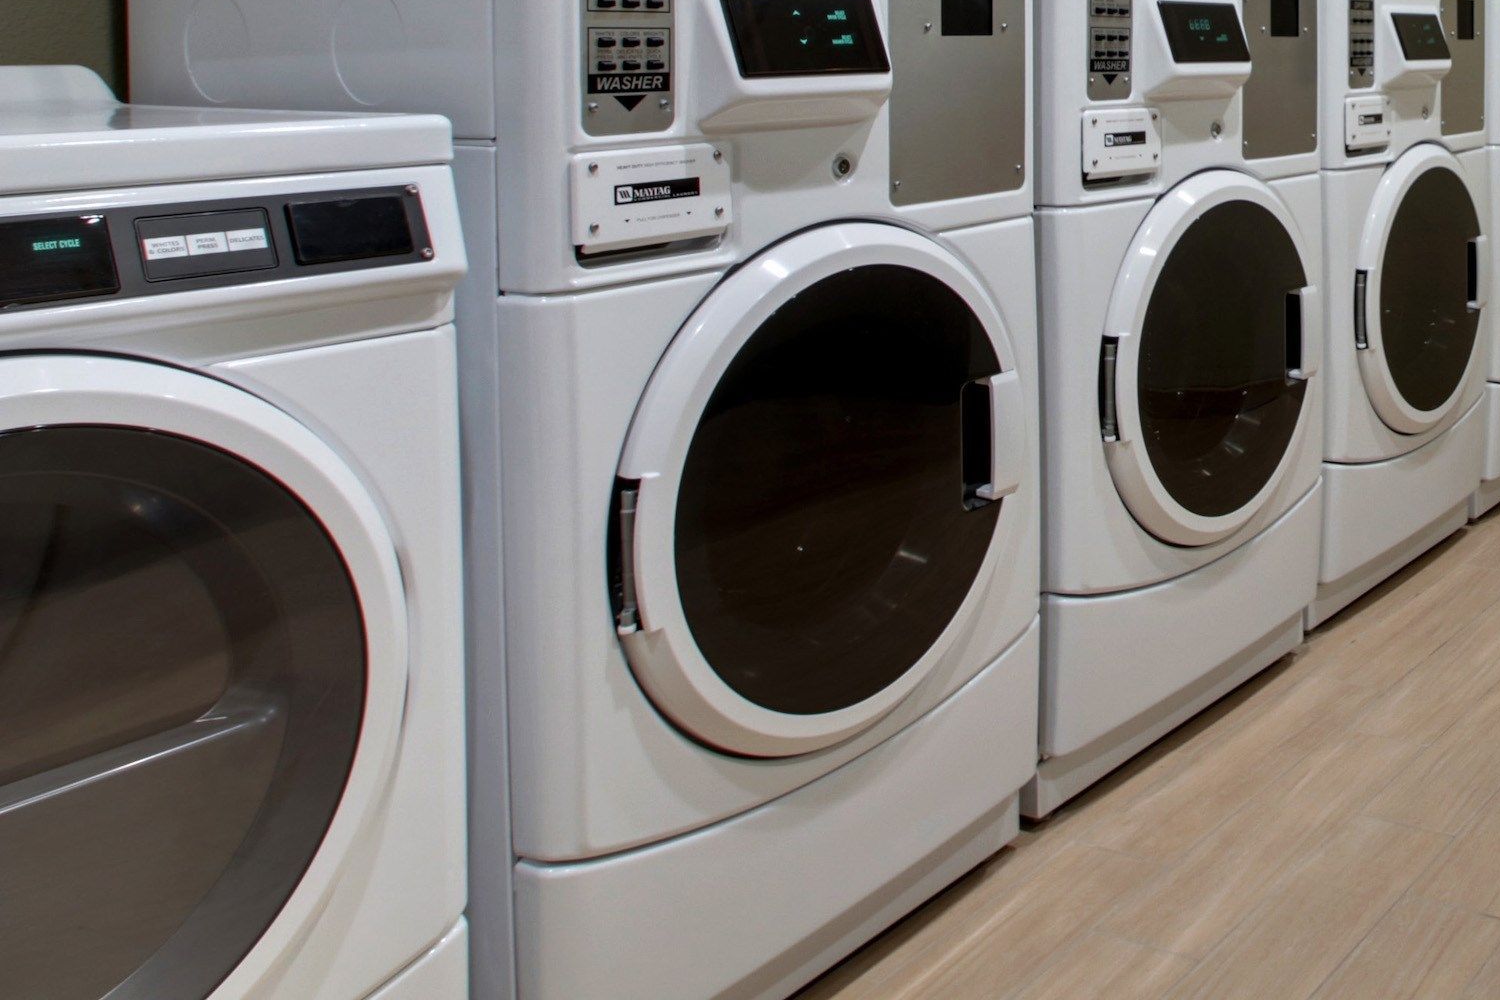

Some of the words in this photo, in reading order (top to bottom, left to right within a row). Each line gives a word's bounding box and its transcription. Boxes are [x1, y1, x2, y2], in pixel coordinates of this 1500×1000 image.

[1093, 60, 1127, 71] WASHER
[596, 75, 663, 91] WASHER
[633, 185, 671, 198] MAYTAG
[32, 240, 58, 251] SELECT
[59, 238, 81, 249] CYCLE
[151, 240, 180, 249] WHITES
[229, 235, 265, 244] DELICATES
[157, 247, 185, 255] COLORS
